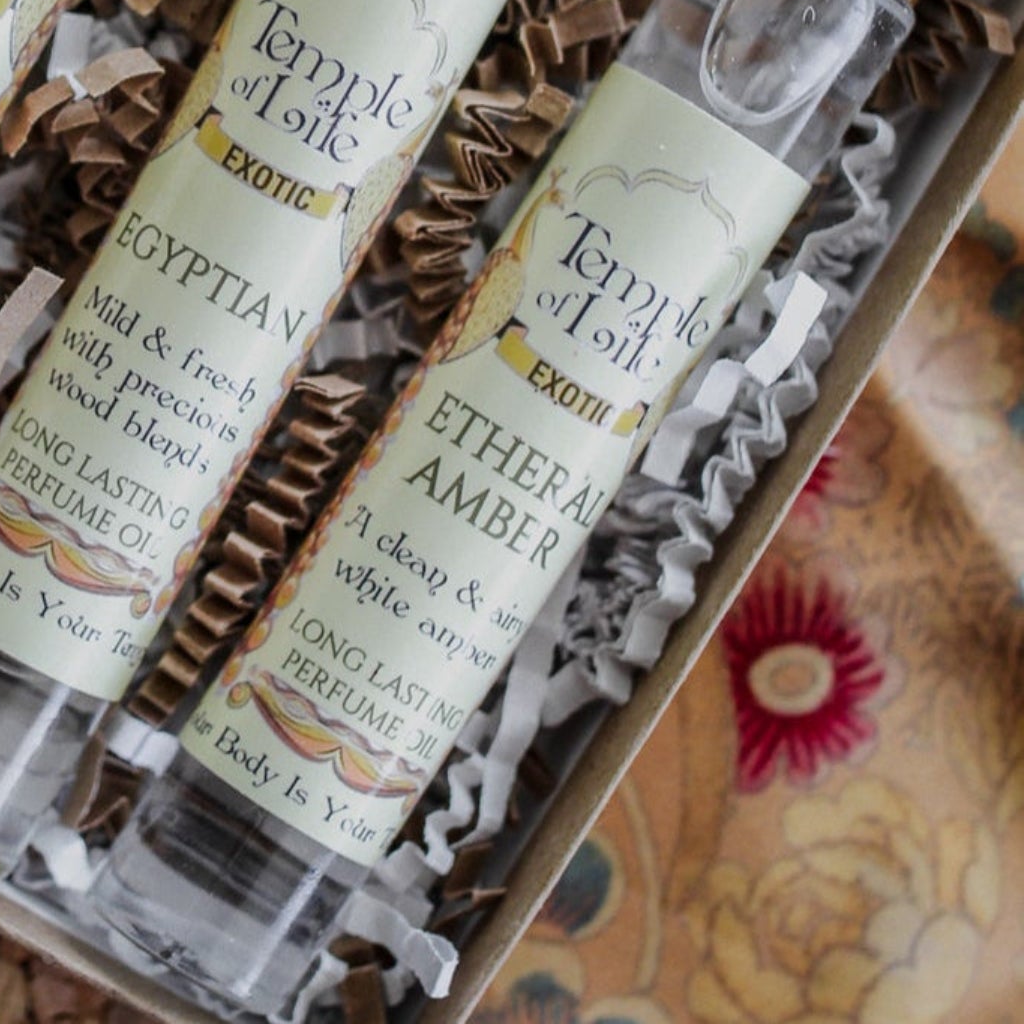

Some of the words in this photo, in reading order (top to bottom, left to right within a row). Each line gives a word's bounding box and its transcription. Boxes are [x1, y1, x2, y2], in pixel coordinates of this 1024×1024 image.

[230, 75, 270, 101] of
[254, 72, 359, 164] Life
[222, 143, 316, 211] EXOTIC
[116, 211, 308, 344] EGYPTIAN
[536, 290, 579, 317] of
[558, 211, 711, 349] Temple
[62, 326, 114, 379] with
[83, 284, 141, 339] Mild
[142, 326, 173, 360] &
[180, 347, 258, 414] fresh
[526, 359, 616, 426] EXOTIC
[10, 407, 75, 466] LONG
[75, 453, 191, 531] LASTING
[48, 368, 119, 421] wood
[122, 409, 212, 475] blends
[423, 389, 606, 528] ETHERAL
[0, 447, 117, 534] PERFUME
[404, 455, 561, 571] AMBER
[334, 556, 411, 619] white
[344, 503, 373, 539] A
[376, 531, 449, 596] clean
[456, 578, 485, 613] &
[38, 591, 103, 643] Your
[289, 607, 367, 673] LONG
[367, 661, 466, 732] LASTING
[280, 647, 404, 742] PERFUME
[214, 725, 280, 789] Body
[283, 775, 311, 806] Is
[322, 795, 377, 845] Your
